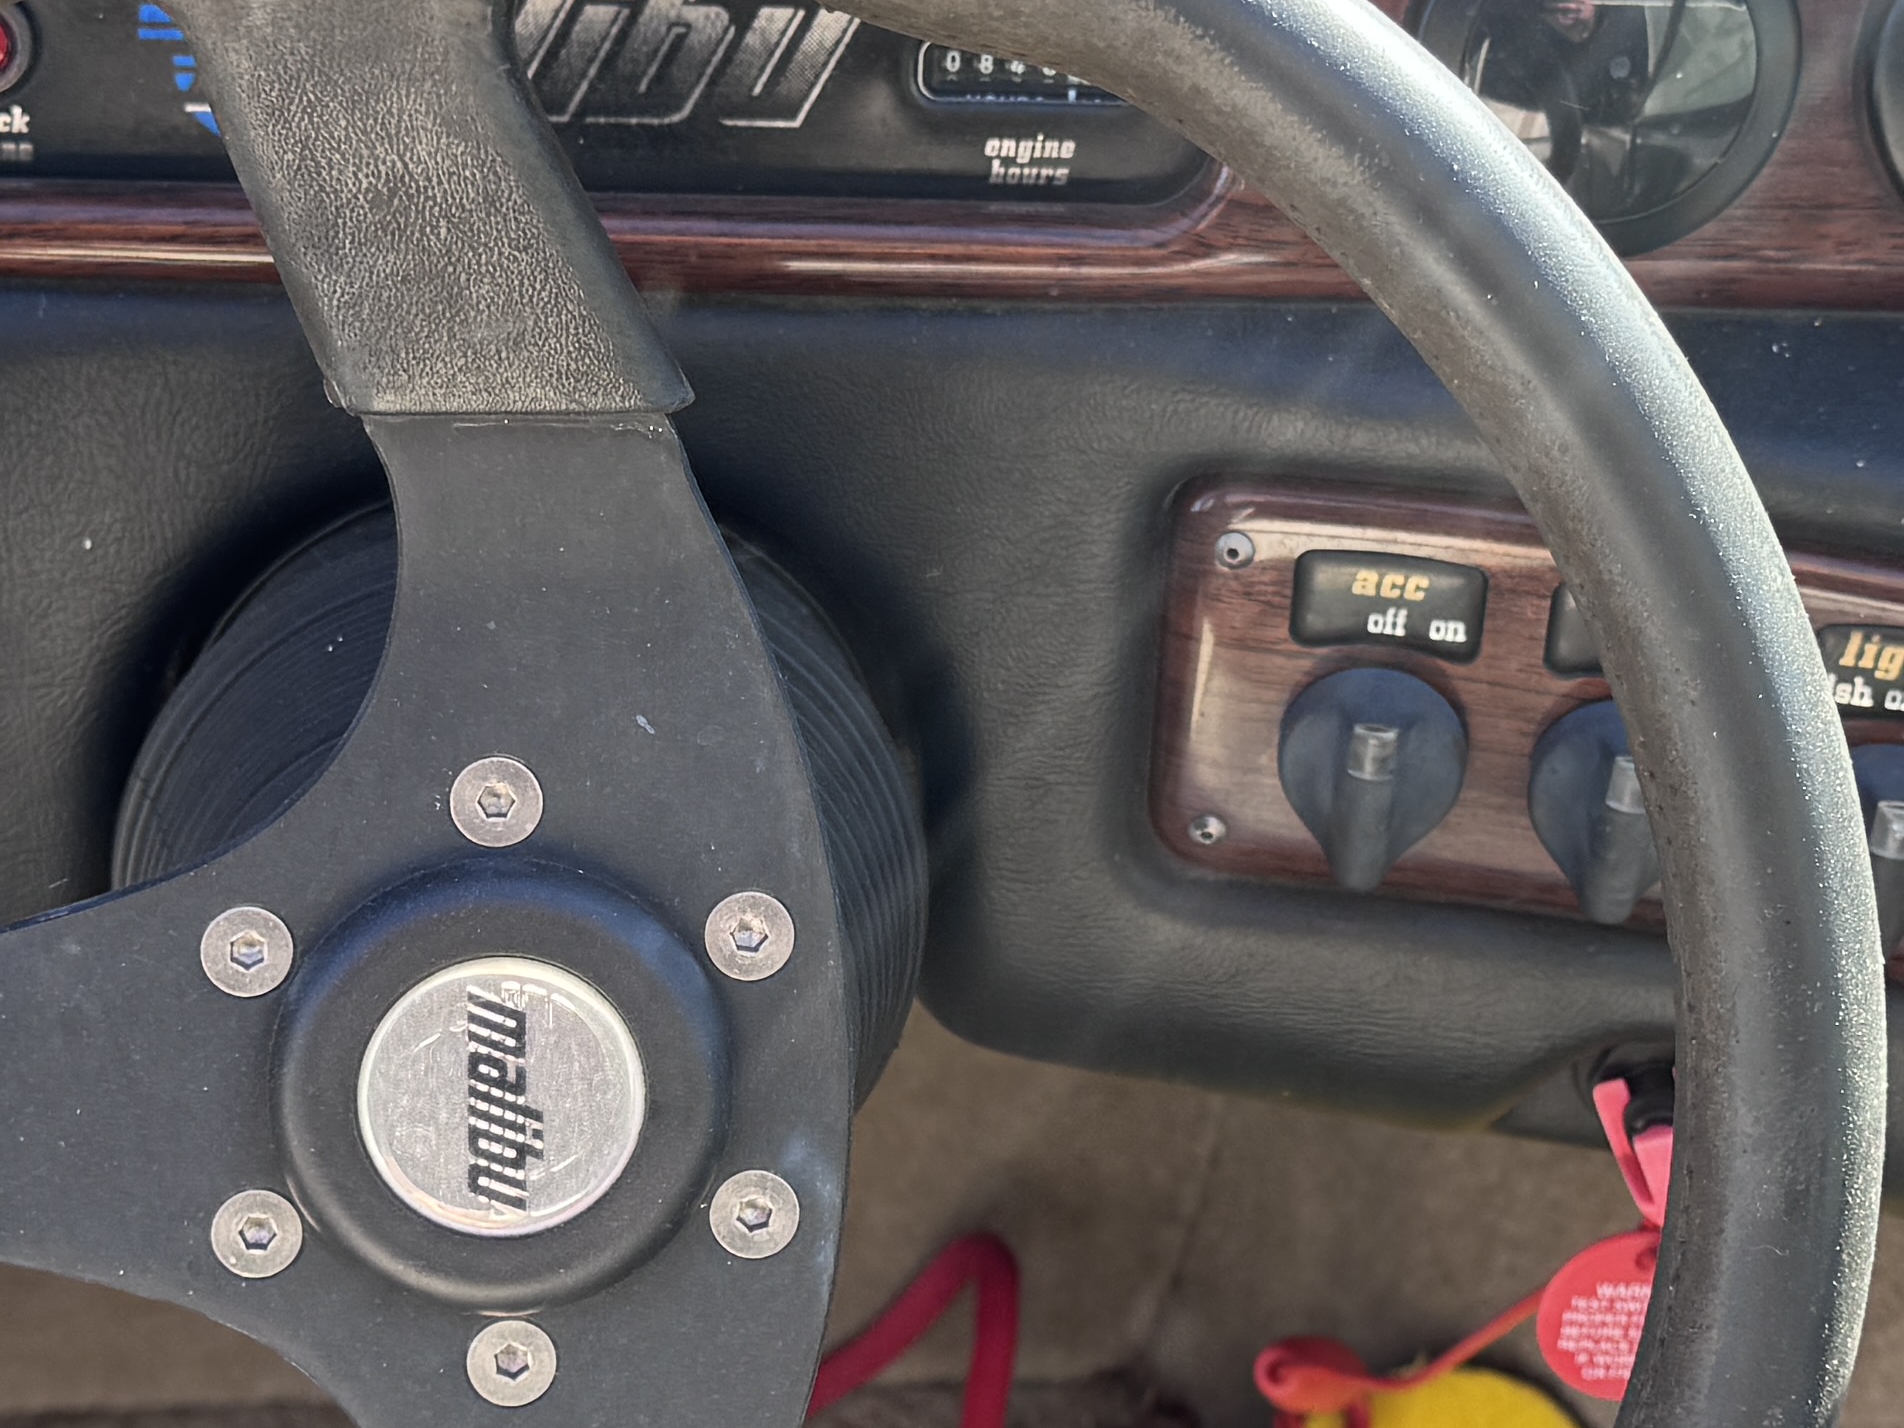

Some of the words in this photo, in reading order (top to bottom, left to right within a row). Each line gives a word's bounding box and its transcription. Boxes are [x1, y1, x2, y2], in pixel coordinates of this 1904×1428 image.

[984, 132, 1076, 164] engine
[989, 158, 1070, 185] hours
[1351, 570, 1430, 601] acc
[1366, 607, 1408, 637] off
[1429, 619, 1467, 642] on
[467, 986, 545, 1212] malibu
